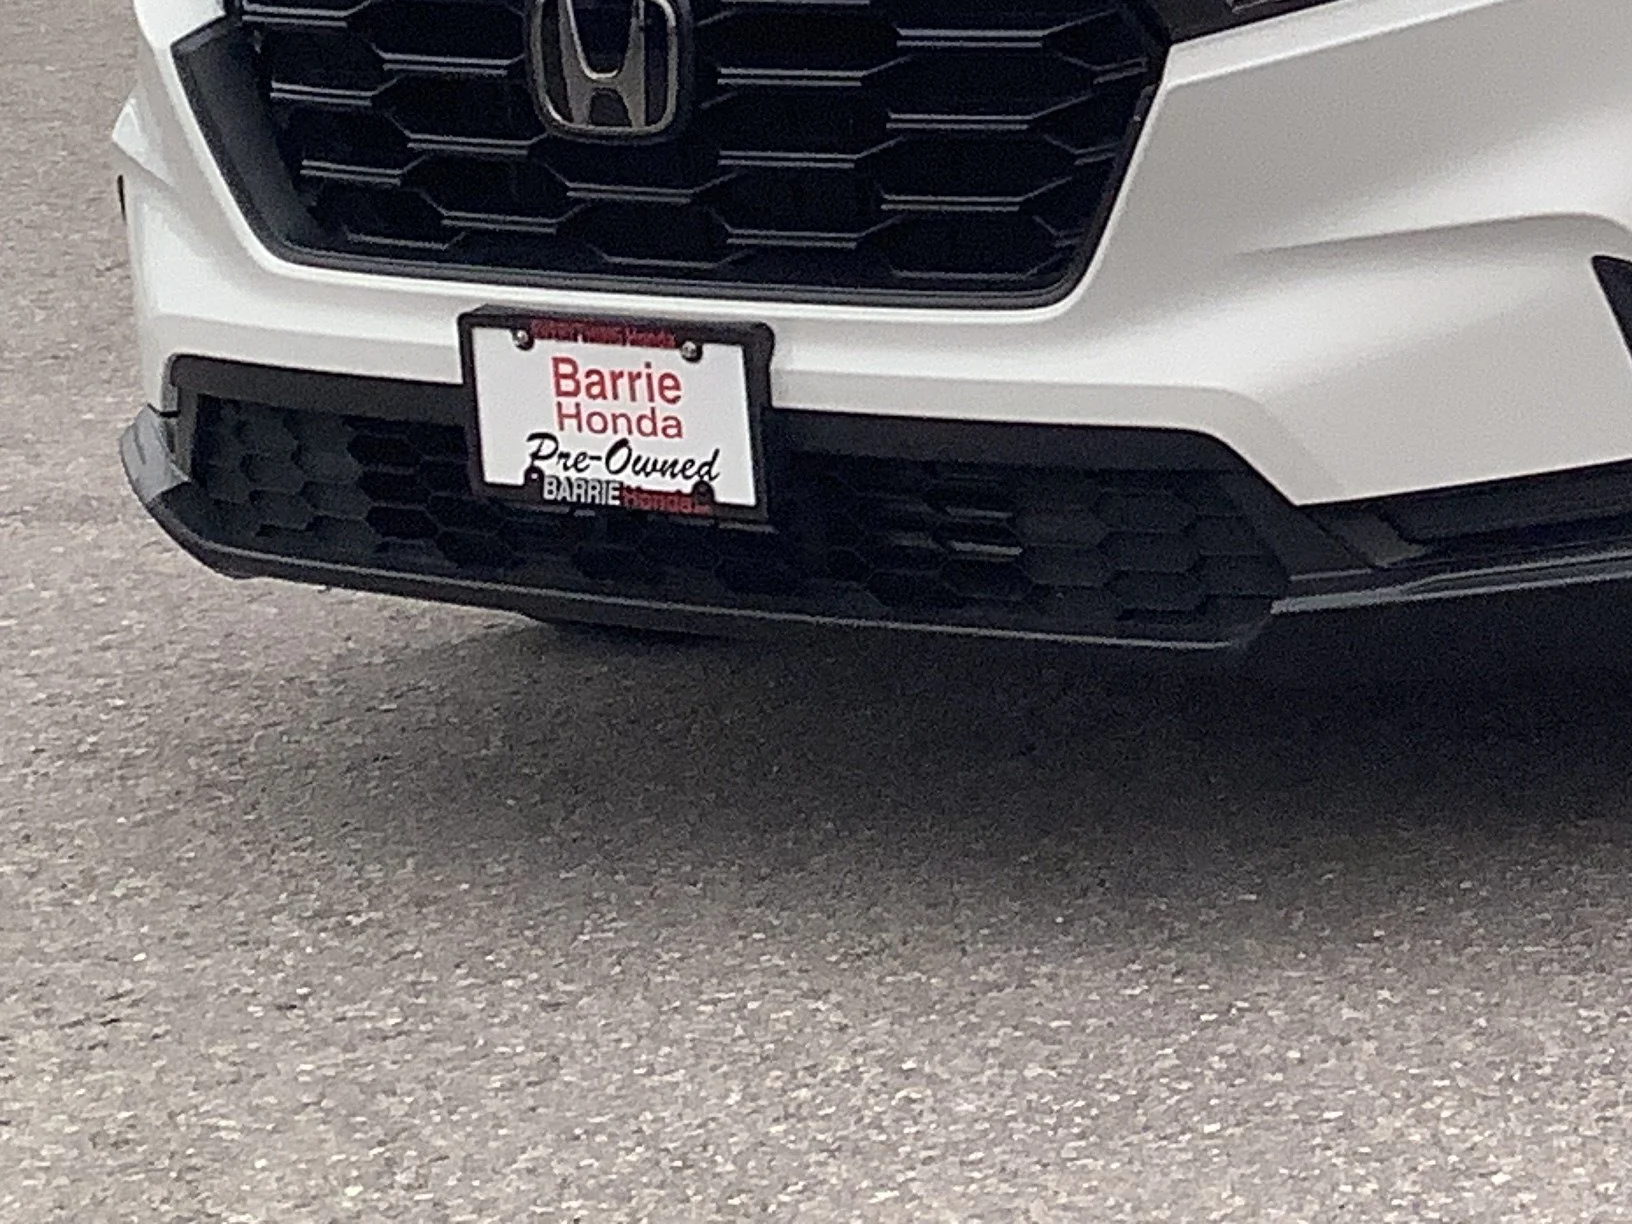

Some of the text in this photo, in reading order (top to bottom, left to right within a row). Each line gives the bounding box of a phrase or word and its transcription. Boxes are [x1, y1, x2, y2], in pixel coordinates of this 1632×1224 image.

[551, 356, 683, 405] Barrie
[555, 401, 684, 439] Honda
[526, 432, 721, 481] Pre-Owned
